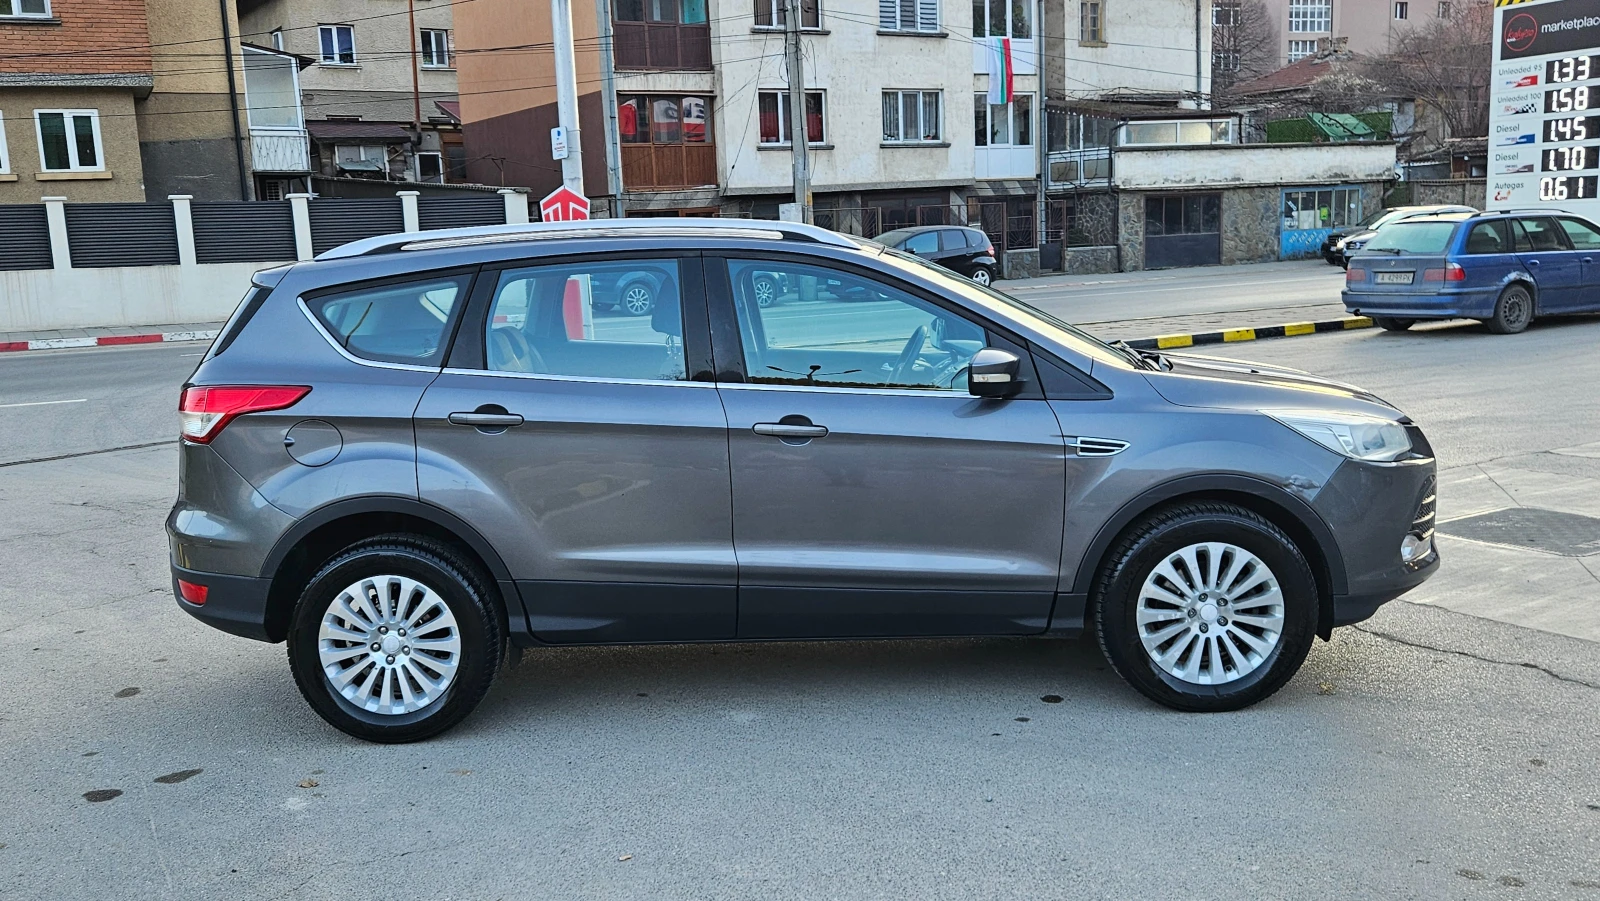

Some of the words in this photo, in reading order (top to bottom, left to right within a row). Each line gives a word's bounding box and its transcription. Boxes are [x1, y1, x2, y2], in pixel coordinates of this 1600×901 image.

[1498, 66, 1531, 76] Unleaded
[1533, 64, 1543, 72] 95
[1497, 94, 1529, 104] Unleaded
[1530, 92, 1542, 100] 100
[1496, 123, 1520, 133] Diesel
[1495, 152, 1519, 162] Diesel
[1494, 182, 1525, 191] Autogas
